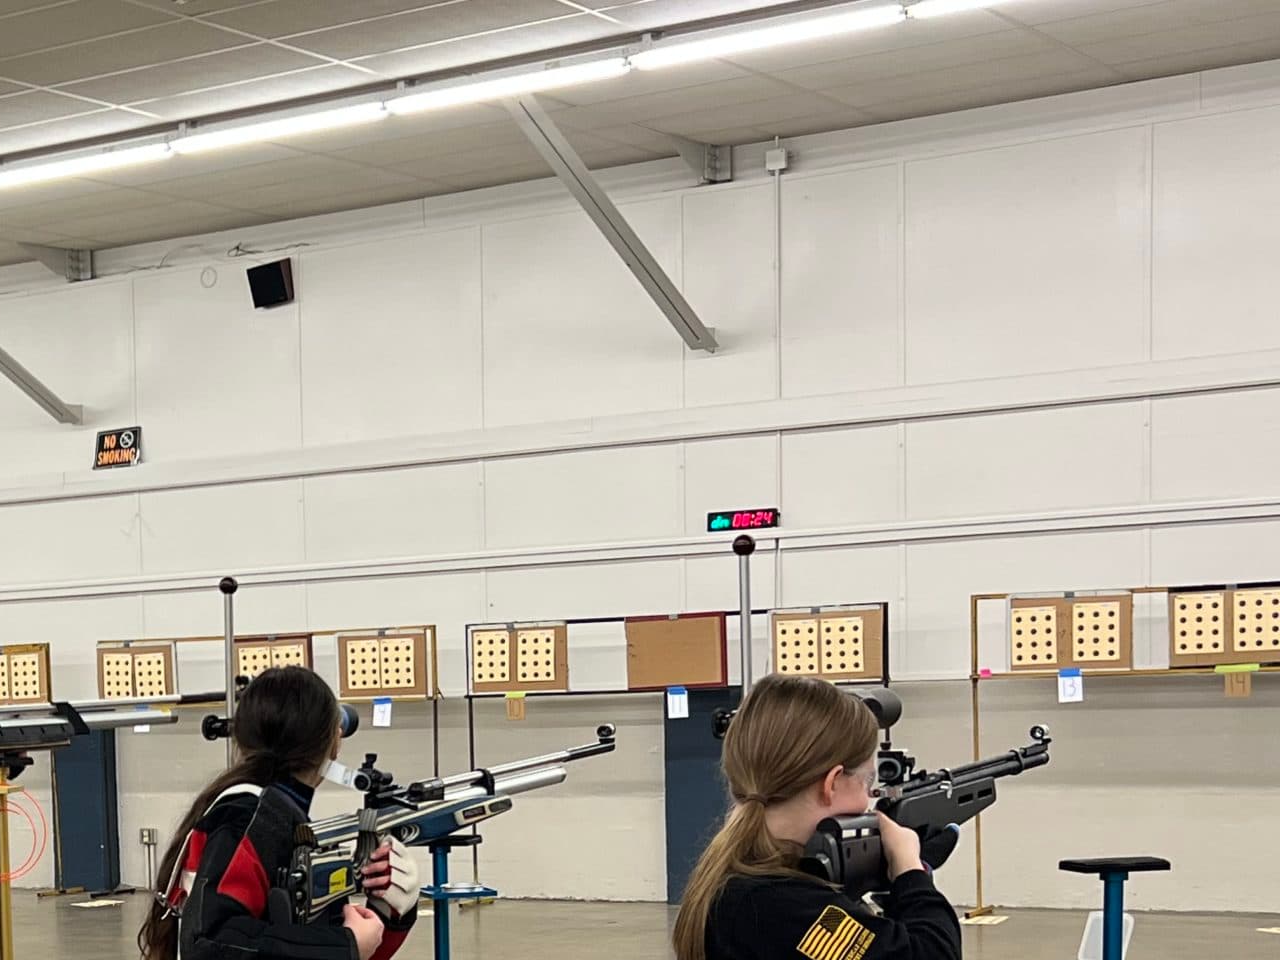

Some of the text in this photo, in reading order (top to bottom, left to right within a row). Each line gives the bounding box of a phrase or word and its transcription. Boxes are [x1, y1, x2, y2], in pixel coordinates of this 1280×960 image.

[104, 434, 116, 449] NO
[98, 448, 136, 465] SMOKING
[1063, 678, 1077, 697] 13
[1231, 672, 1245, 693] 14
